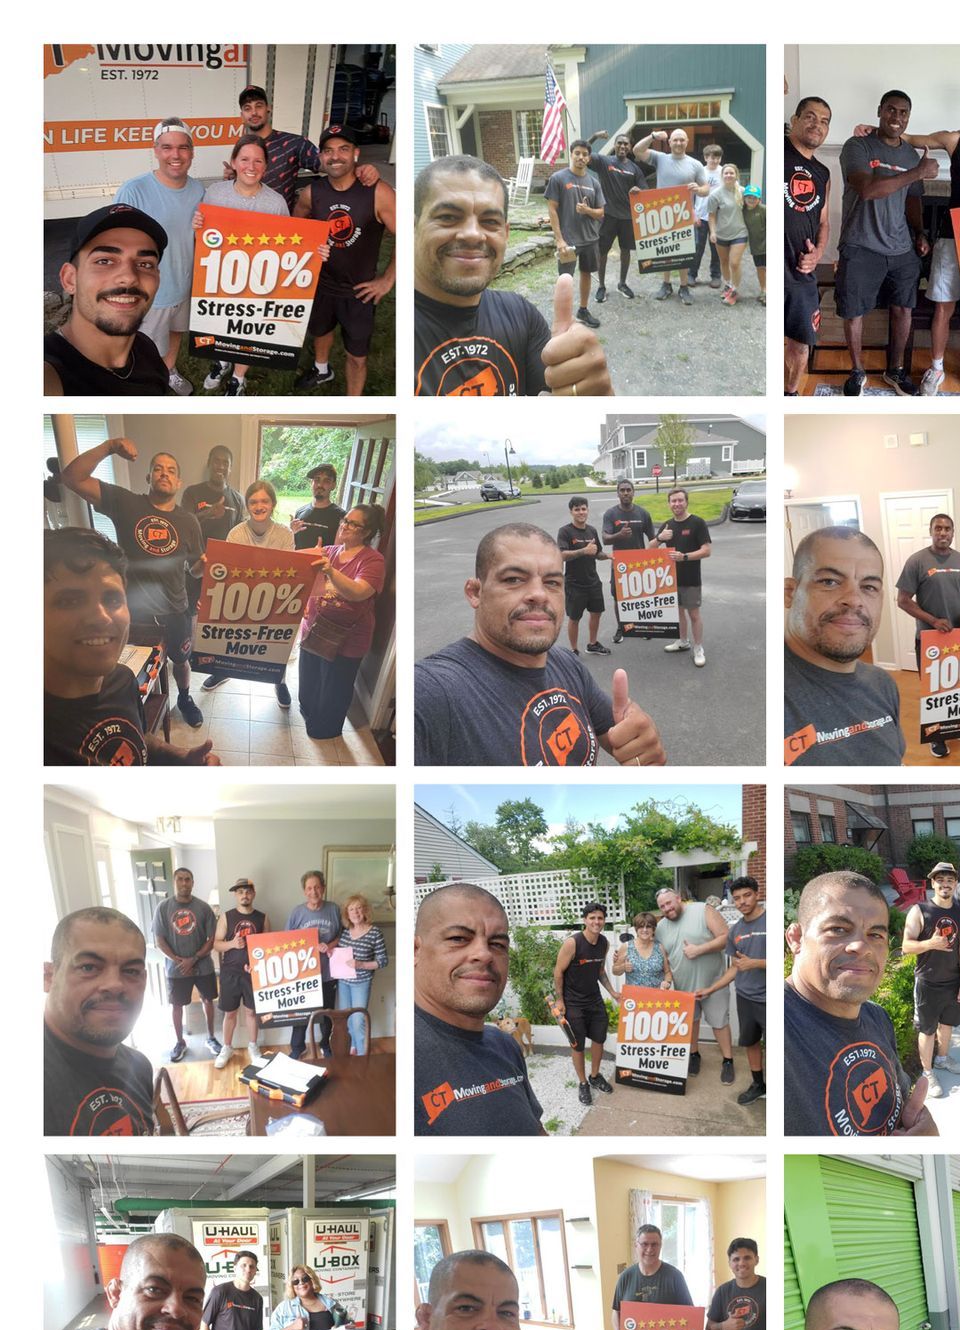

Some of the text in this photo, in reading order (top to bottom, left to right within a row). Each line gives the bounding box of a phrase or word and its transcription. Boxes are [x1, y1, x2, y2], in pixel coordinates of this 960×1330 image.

[101, 70, 159, 80] EST. 1972
[62, 128, 107, 144] LIFE
[114, 127, 153, 142] KEE
[635, 200, 690, 236] 100%
[639, 228, 691, 249] Stress-Free
[656, 242, 680, 256] Move
[200, 249, 313, 295] 100%
[197, 297, 305, 318] Stress-Free
[226, 319, 275, 336] Move
[618, 565, 673, 597] 100%
[206, 581, 305, 621] 100%
[621, 595, 674, 611] Stress-Free
[638, 609, 662, 620] Move
[201, 623, 293, 640] Stress-Free
[225, 641, 267, 655] Move
[254, 946, 317, 986] 100%
[258, 978, 318, 1001] Stress-Free
[277, 994, 305, 1009] Move
[622, 1011, 688, 1040] 100%
[621, 1043, 685, 1056] Stress-Free
[638, 1057, 668, 1069] Move
[314, 1255, 360, 1268] U-BOX
